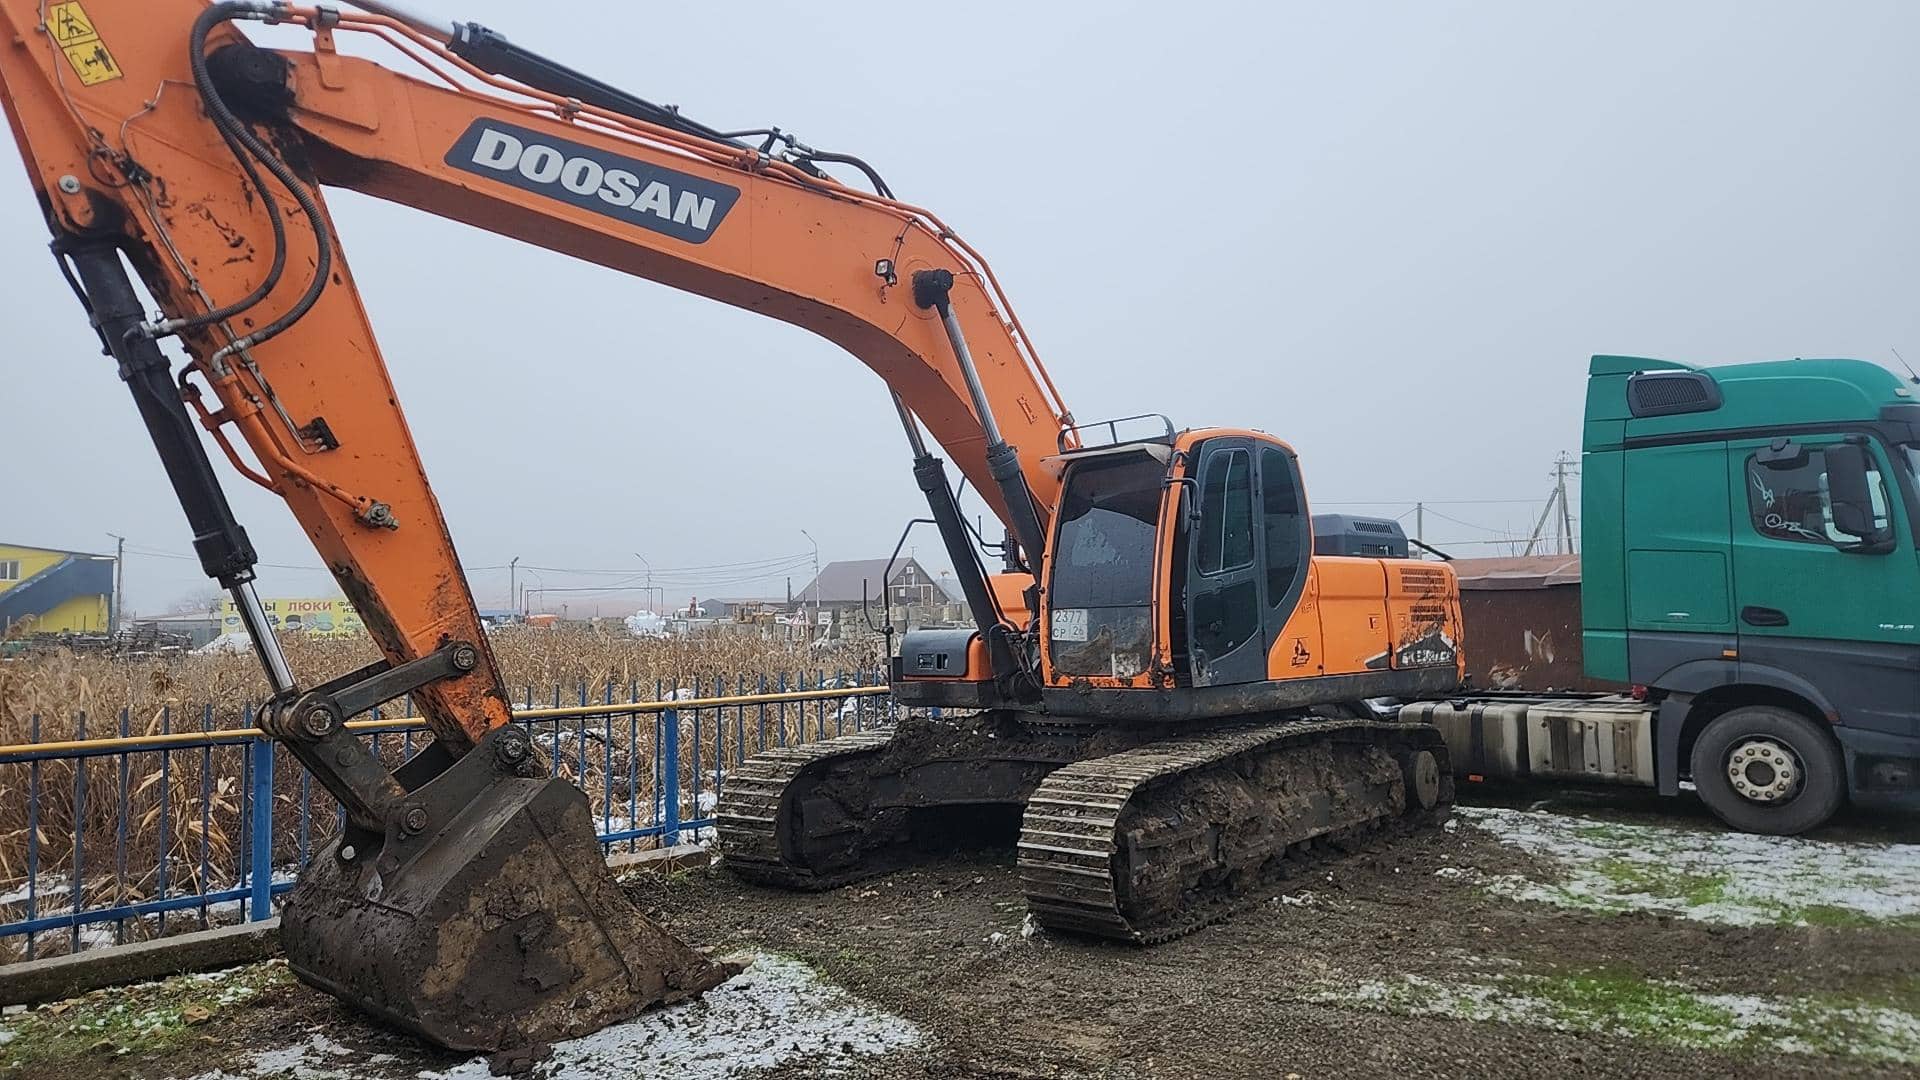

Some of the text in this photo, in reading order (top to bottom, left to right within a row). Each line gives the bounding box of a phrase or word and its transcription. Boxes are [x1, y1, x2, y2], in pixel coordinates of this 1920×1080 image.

[472, 128, 715, 230] DOOSAN
[288, 602, 331, 611] ЛЮКИ
[1055, 610, 1081, 623] 2377
